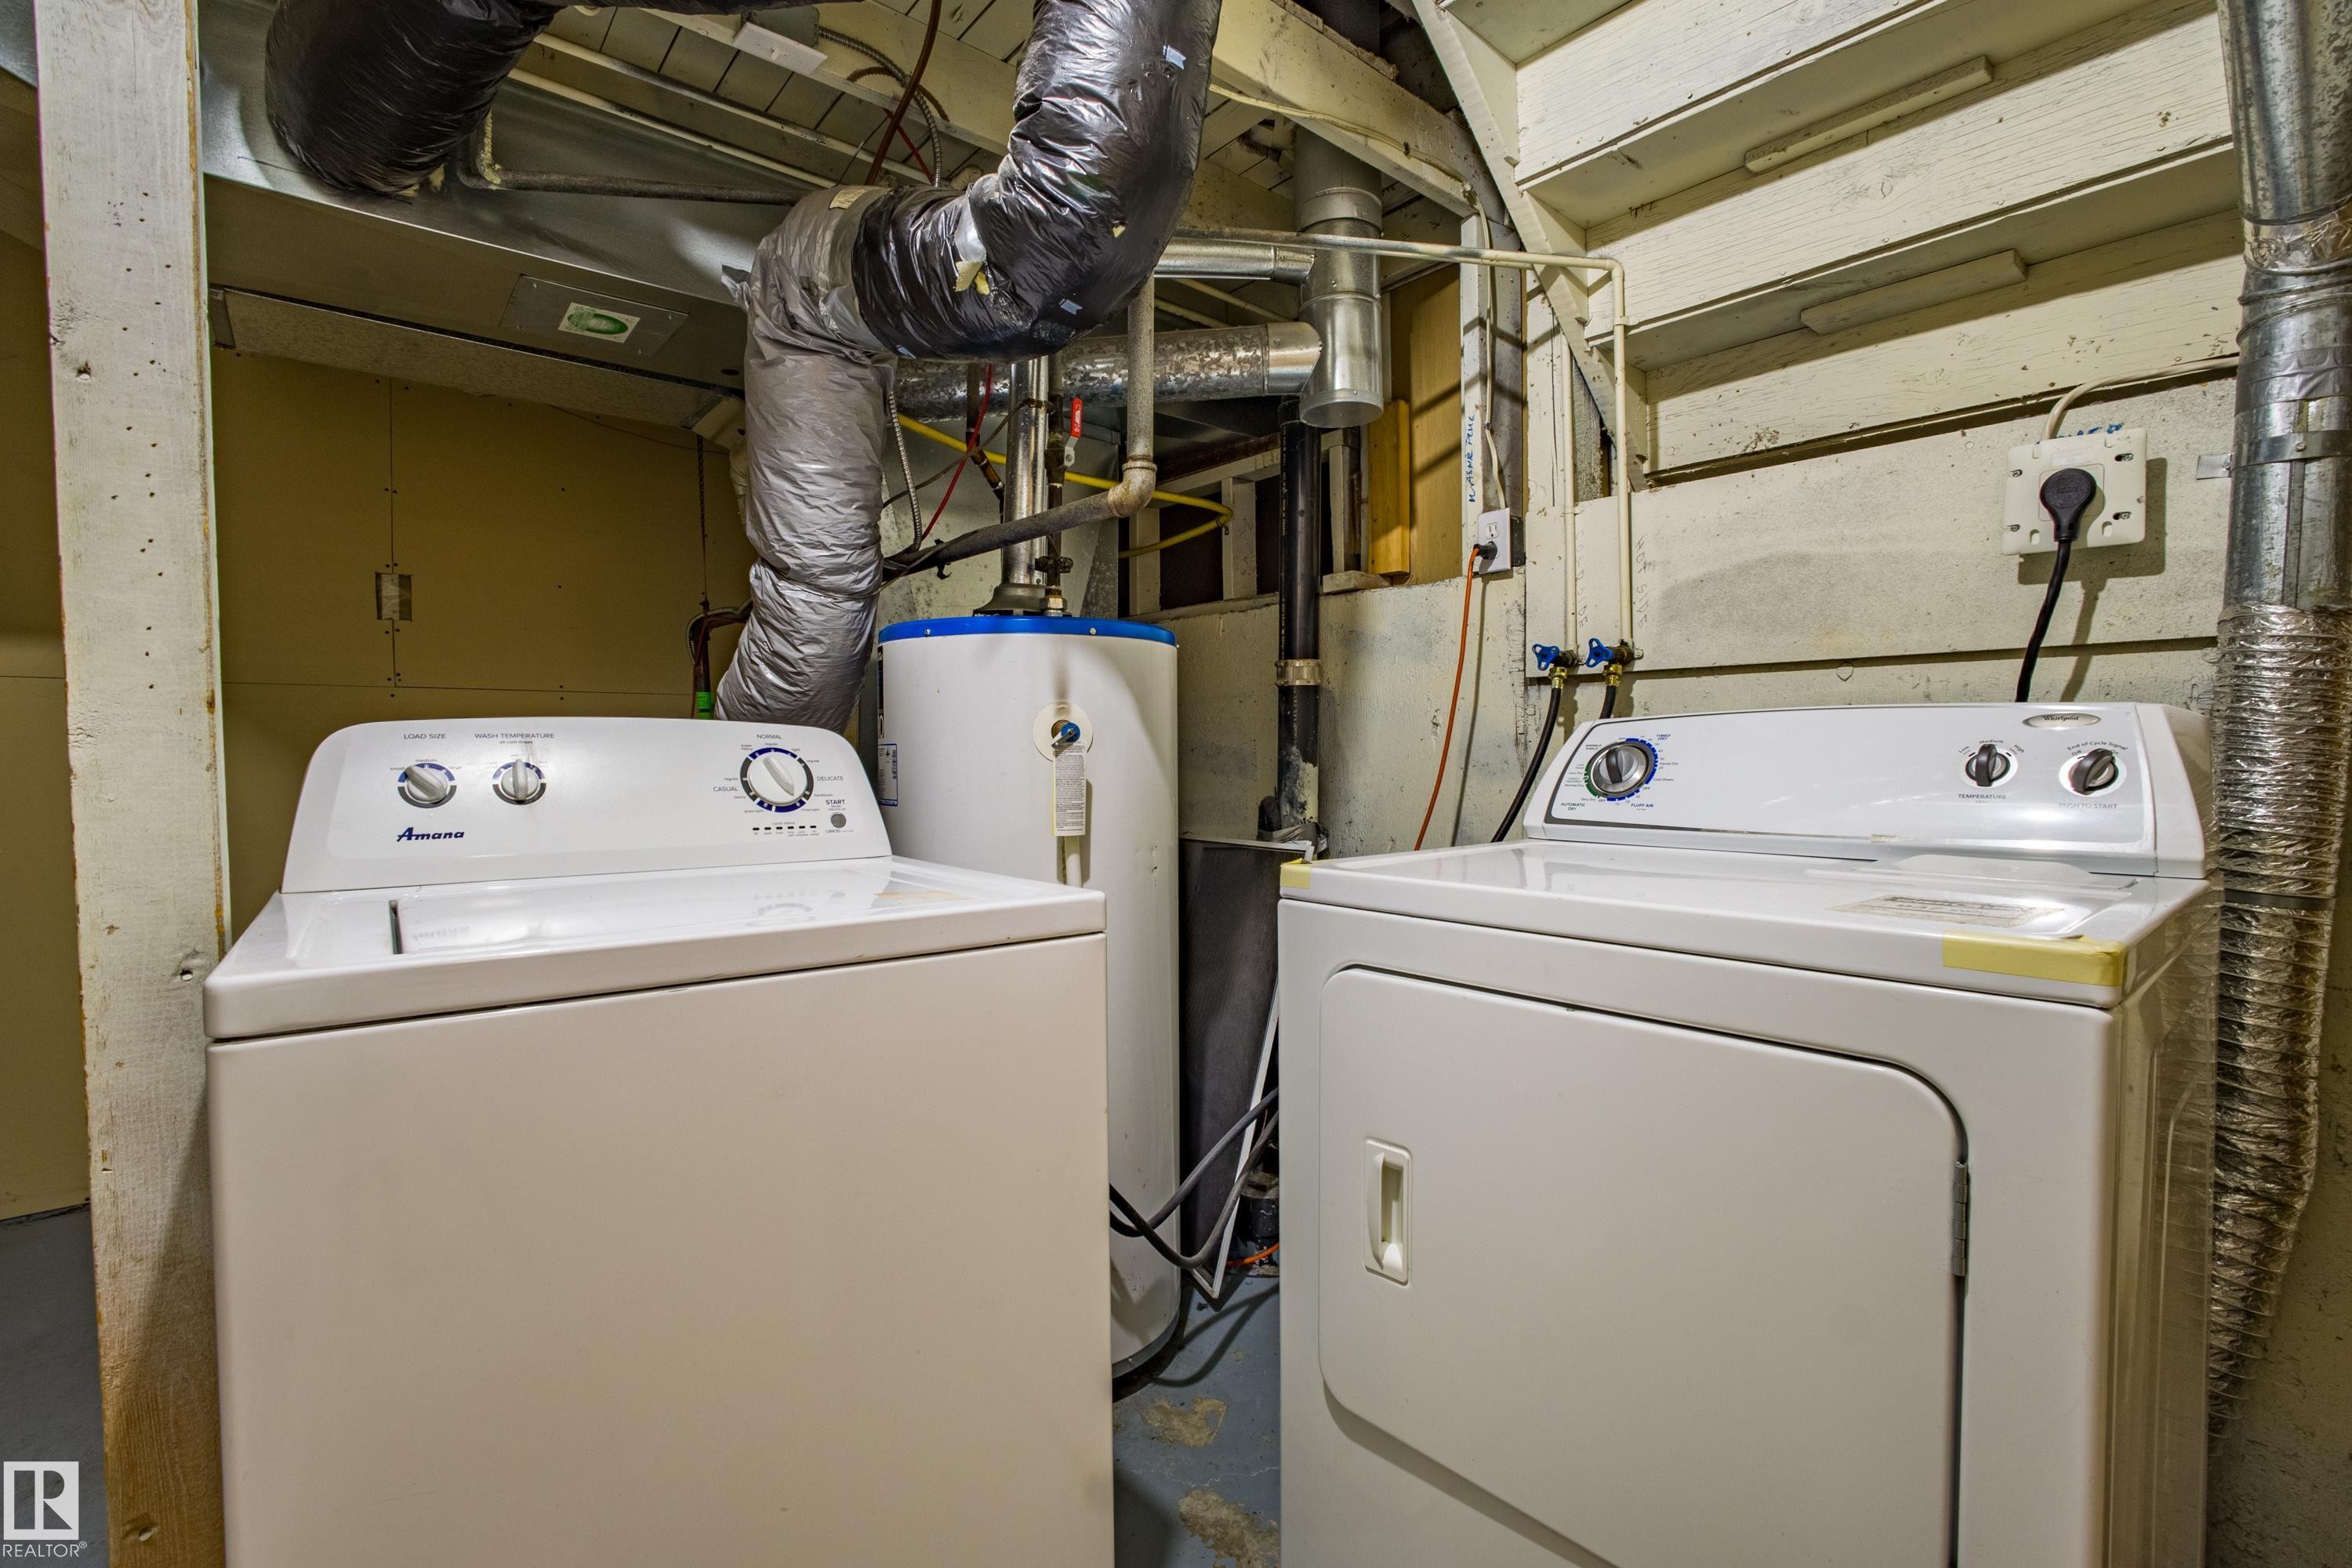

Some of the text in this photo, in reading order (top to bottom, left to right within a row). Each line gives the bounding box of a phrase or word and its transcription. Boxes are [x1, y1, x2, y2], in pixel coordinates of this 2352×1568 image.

[1577, 586, 1588, 628] SIDE
[1637, 584, 1649, 629] SIDE
[2013, 745, 2025, 753] High
[2108, 742, 2129, 751] Signal
[397, 826, 465, 843] Amana
